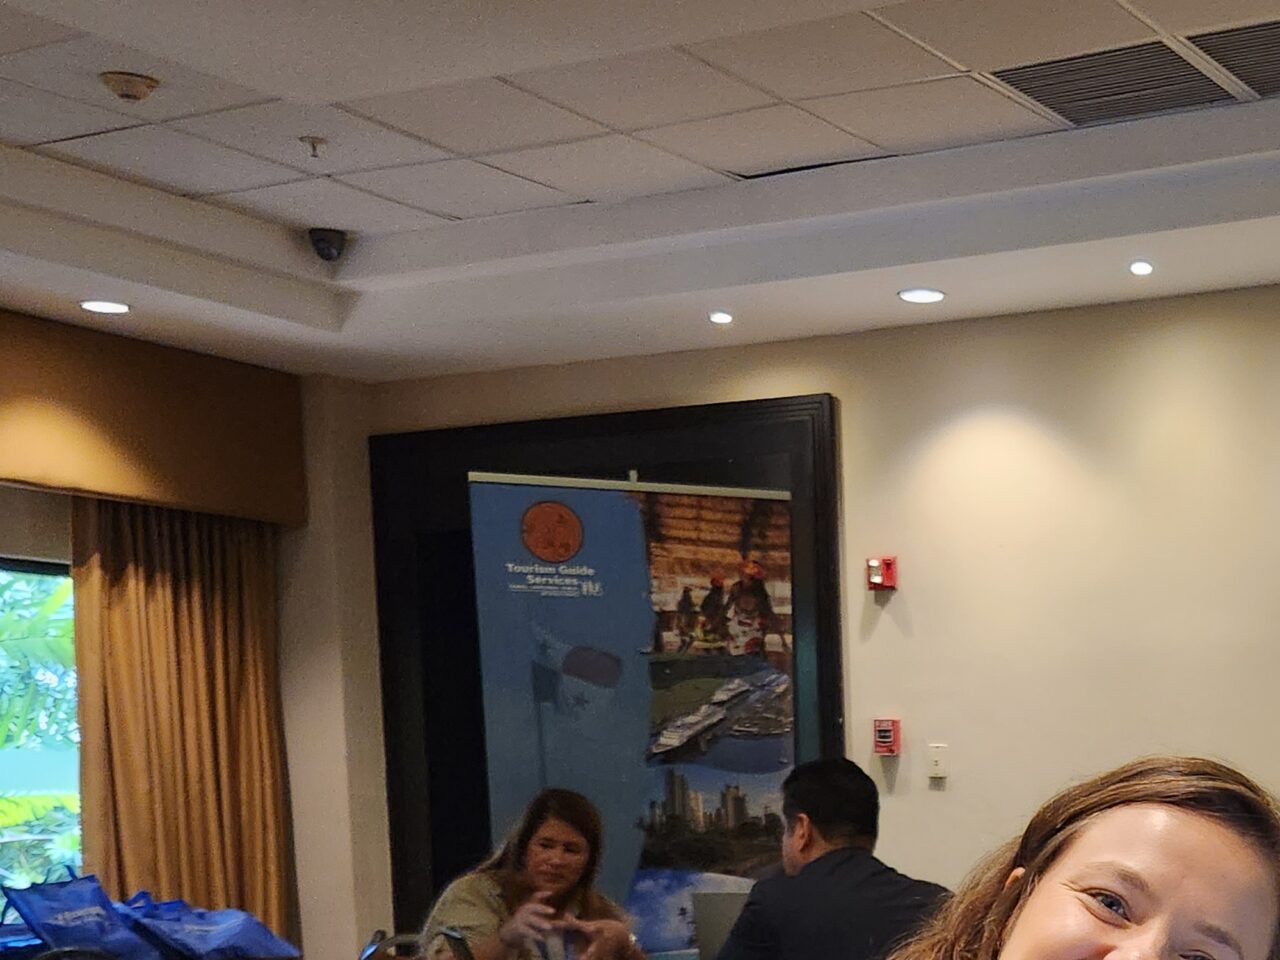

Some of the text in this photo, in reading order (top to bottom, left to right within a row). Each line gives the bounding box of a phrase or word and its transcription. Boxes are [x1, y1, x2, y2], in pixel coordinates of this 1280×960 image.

[505, 563, 595, 576] Tourism Guide
[526, 575, 578, 584] Services
